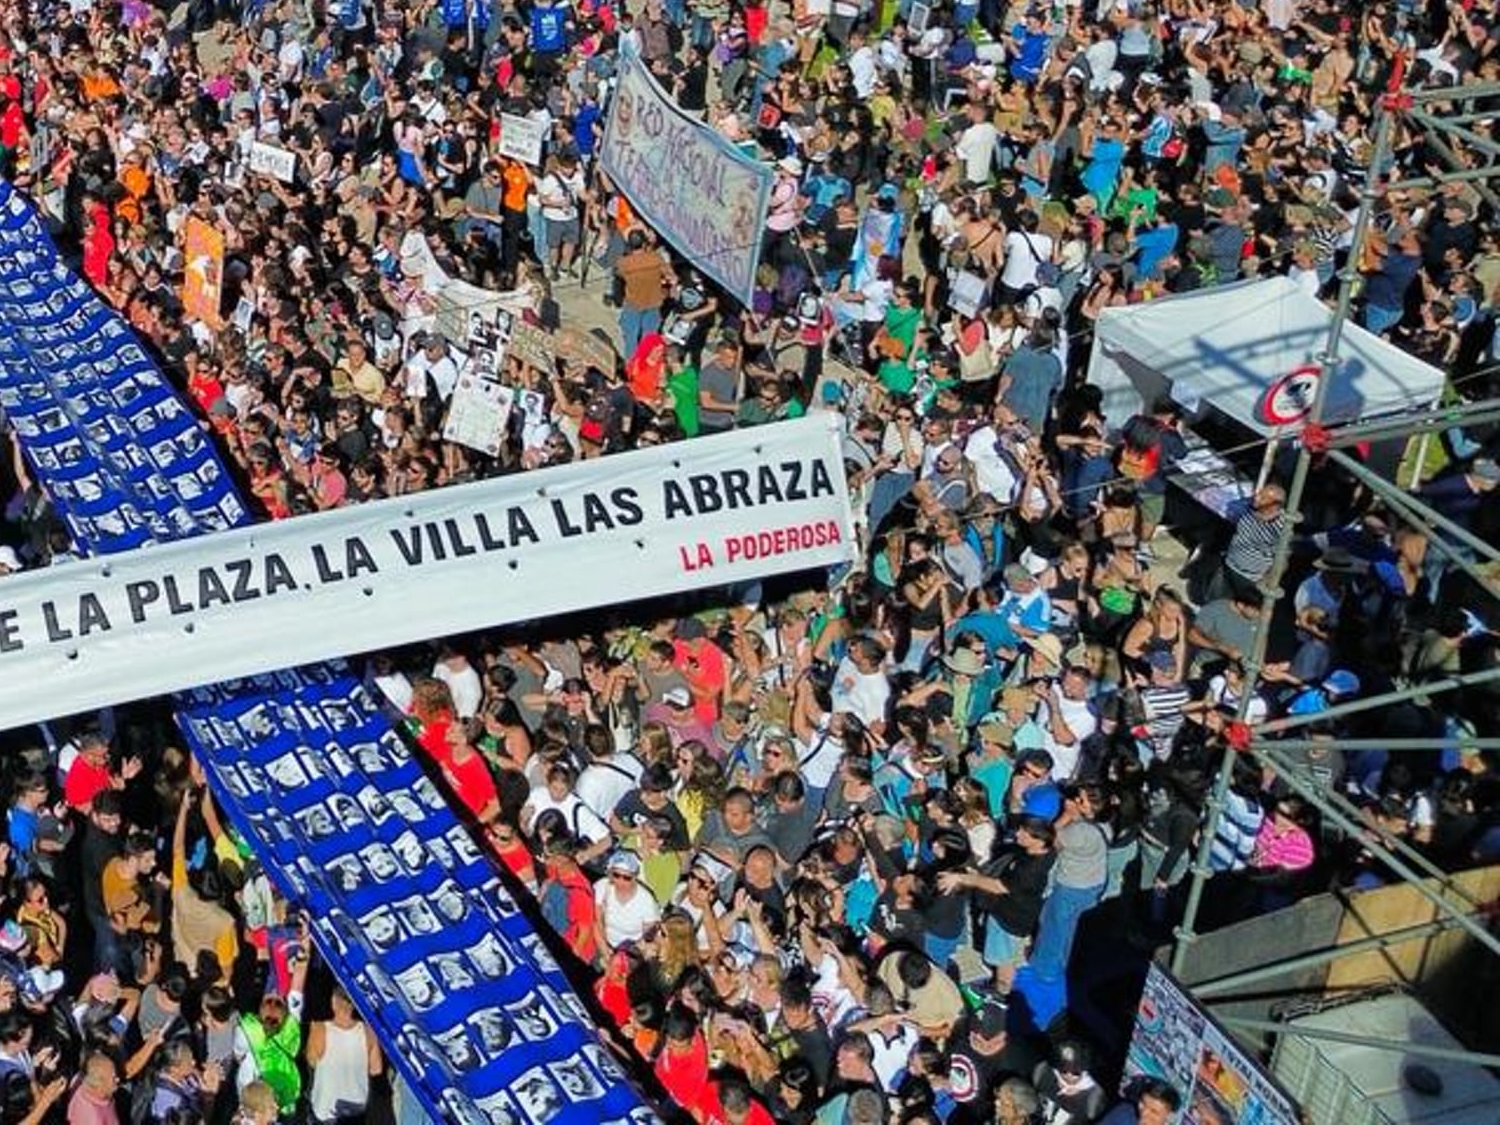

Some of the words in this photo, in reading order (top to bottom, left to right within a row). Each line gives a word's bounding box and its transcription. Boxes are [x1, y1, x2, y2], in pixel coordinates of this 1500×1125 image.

[42, 591, 111, 643] LA
[311, 536, 380, 585] LA
[390, 505, 539, 567] VILLA
[550, 485, 644, 538] LAS
[662, 457, 836, 521] ABRAZA
[679, 541, 714, 572] LA
[724, 519, 841, 565] PODEROSA
